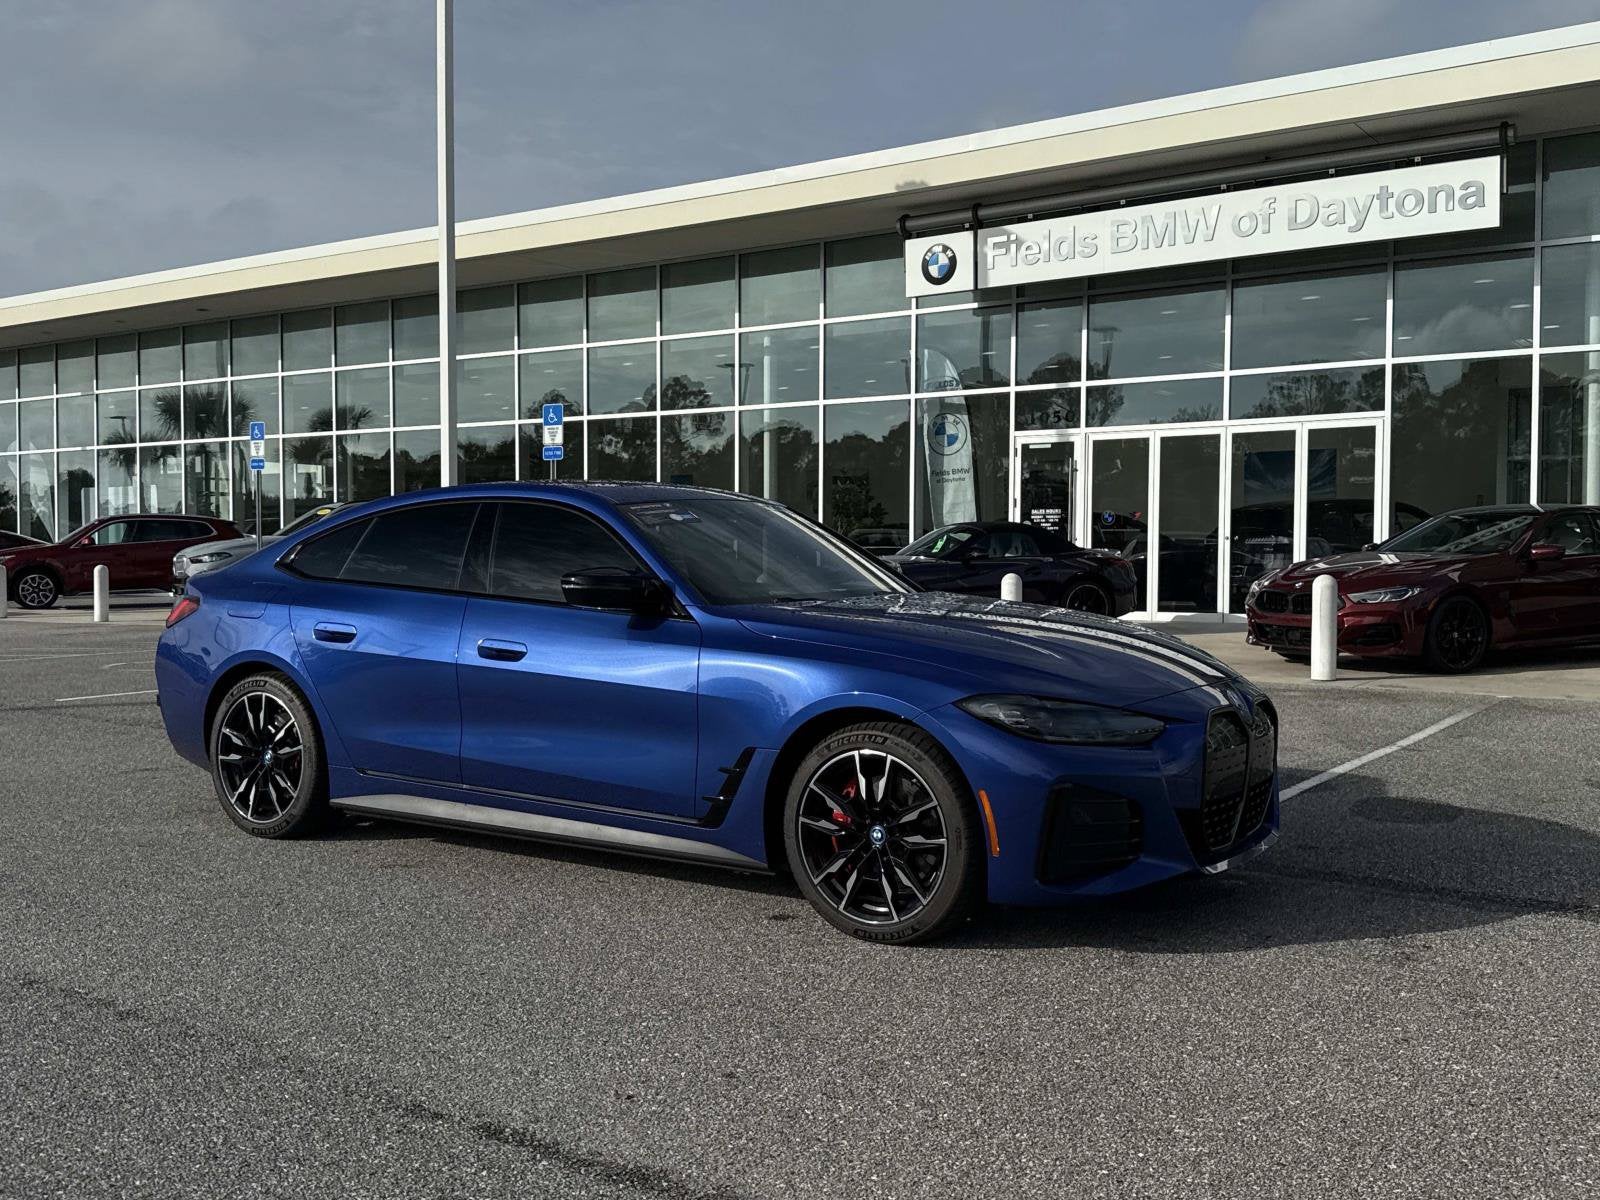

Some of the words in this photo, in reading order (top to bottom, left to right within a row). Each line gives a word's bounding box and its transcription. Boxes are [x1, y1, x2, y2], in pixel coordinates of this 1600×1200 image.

[986, 224, 1098, 270] Fields
[1110, 203, 1221, 254] BMW
[1231, 197, 1276, 238] of
[1287, 179, 1486, 233] Daytona
[925, 245, 954, 260] BMW
[951, 467, 970, 475] BMW
[233, 680, 265, 696] MICHELIN
[829, 734, 885, 750] MICHELIN
